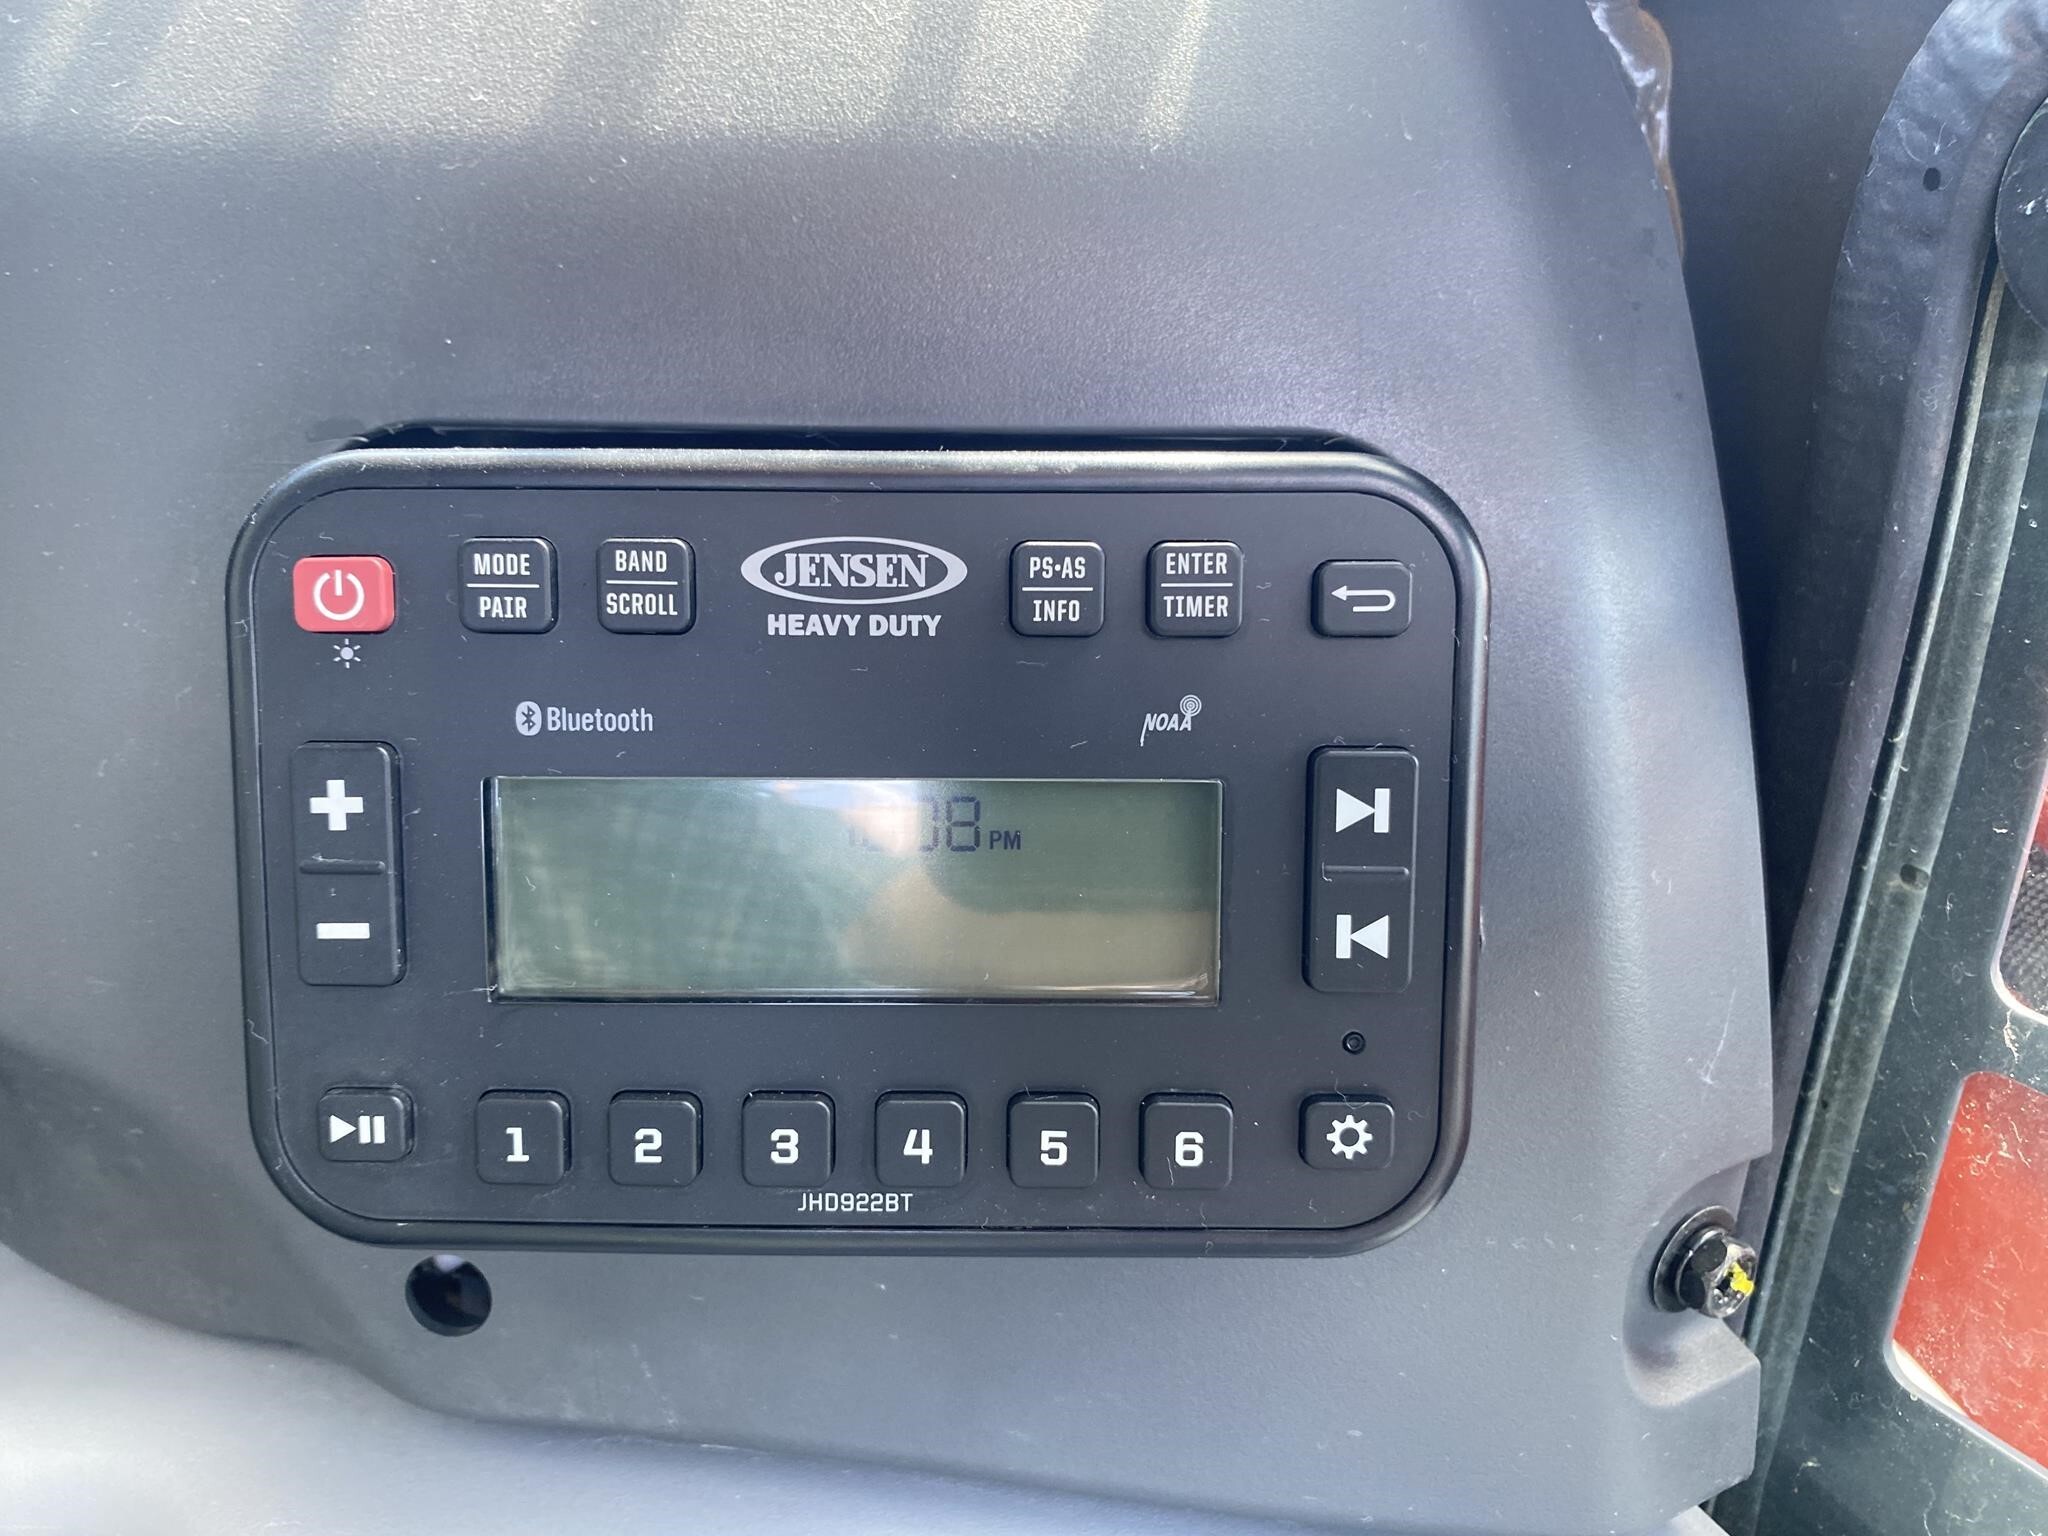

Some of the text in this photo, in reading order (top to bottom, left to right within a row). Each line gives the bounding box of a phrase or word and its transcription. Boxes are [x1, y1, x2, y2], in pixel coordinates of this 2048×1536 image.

[474, 553, 531, 576] MODE
[615, 550, 667, 572] BAND
[774, 553, 930, 588] JENSEN
[1166, 552, 1228, 575] ENTER
[479, 596, 527, 619] PAIR
[606, 592, 678, 616] SCROLL
[1033, 599, 1080, 622] INFO
[1163, 595, 1229, 618] TIMER
[767, 613, 942, 637] HEAVY DUTY
[547, 706, 653, 732] Bluetooth
[1140, 713, 1192, 747] NOAA
[989, 830, 1022, 850] PM
[506, 1127, 529, 1162] 1
[634, 1128, 662, 1163] 2
[770, 1128, 799, 1164] 3
[903, 1129, 933, 1165] 4
[1040, 1130, 1068, 1166] 5
[1174, 1131, 1204, 1167] 6
[797, 1192, 914, 1212] JHD922BT
